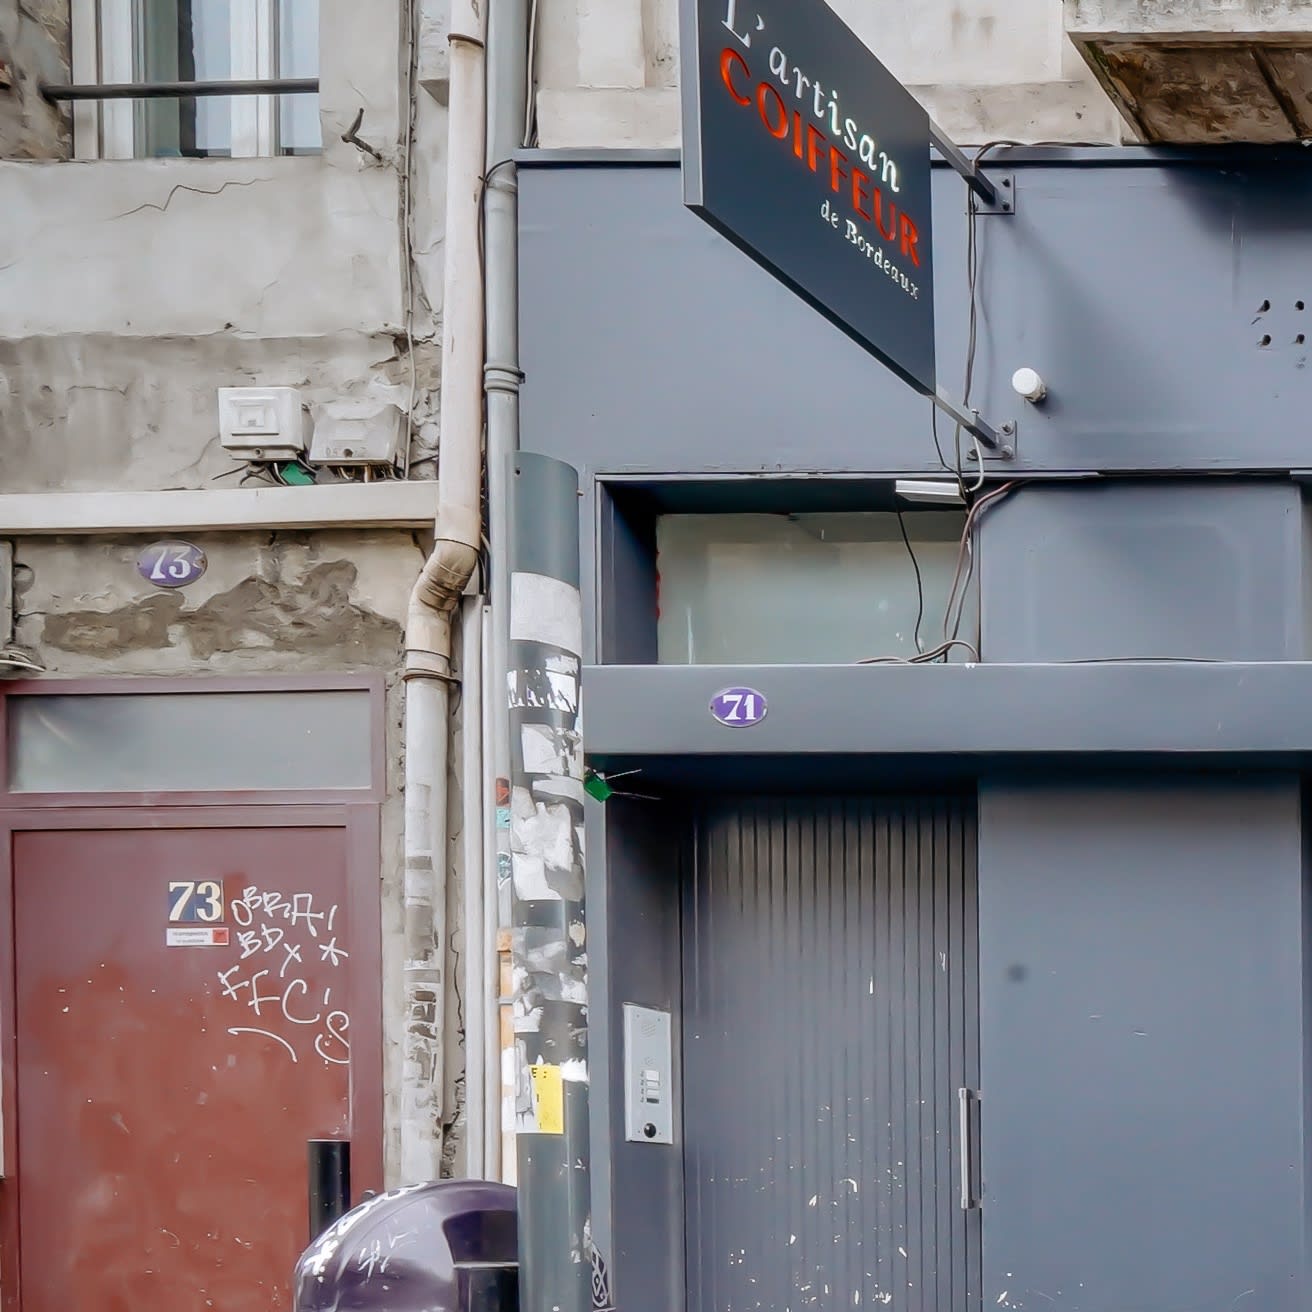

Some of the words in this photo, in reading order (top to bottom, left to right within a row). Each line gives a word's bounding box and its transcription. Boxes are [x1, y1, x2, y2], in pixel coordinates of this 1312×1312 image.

[719, 47, 921, 267] COIFFEUR
[820, 200, 839, 229] de
[845, 218, 920, 300] Bordeaux
[149, 545, 192, 579] 73
[722, 694, 757, 720] 71
[168, 881, 222, 921] 73
